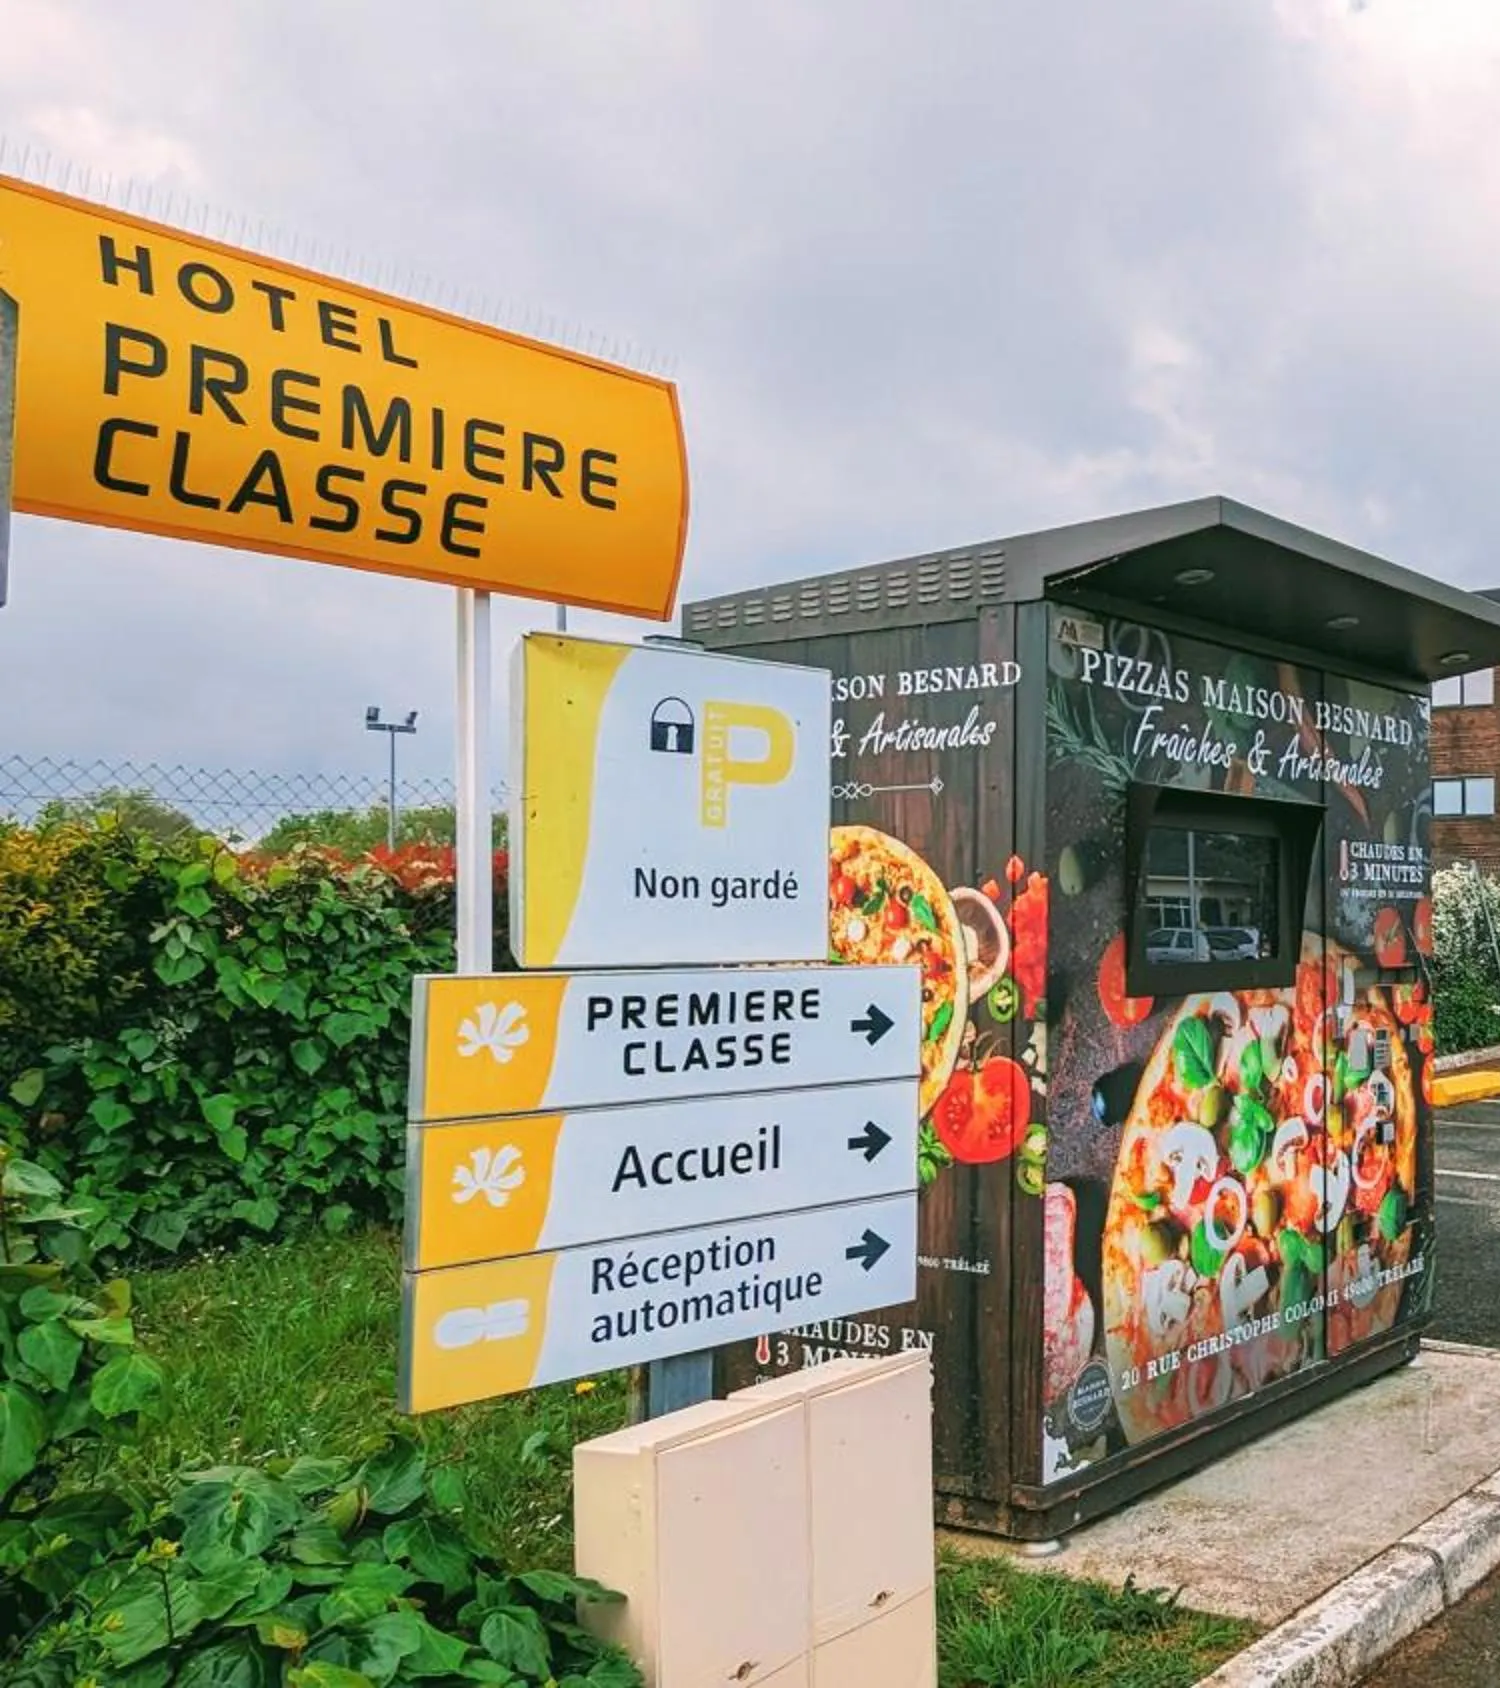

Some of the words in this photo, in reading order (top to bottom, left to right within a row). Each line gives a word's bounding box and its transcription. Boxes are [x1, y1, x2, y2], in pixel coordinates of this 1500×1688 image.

[98, 234, 419, 369] HOTEL
[103, 321, 619, 512] PREMIERE
[92, 417, 488, 558] CLASSE
[831, 675, 887, 702] SON
[897, 661, 1022, 696] BESNARD
[1080, 646, 1191, 703] PIZZAS
[1201, 675, 1305, 726] MAISON
[1315, 701, 1414, 746] BESNARD
[831, 717, 851, 758] &
[857, 704, 997, 757] Artisanales
[1132, 705, 1237, 769] Fraîches
[1247, 730, 1273, 776] &
[1277, 733, 1384, 791] Artisanales
[706, 710, 728, 820] GRATUIT
[1349, 862, 1359, 881] 3
[1363, 863, 1425, 883] MINUTES
[1350, 841, 1405, 861] CHAUDES
[1408, 846, 1423, 861] EN
[634, 867, 701, 900] Non
[711, 870, 798, 908] gardé
[586, 987, 821, 1032] PREMIERE
[622, 1032, 792, 1077] CLASSE
[611, 1124, 782, 1193] Accueil
[591, 1233, 776, 1295] Réception
[589, 1269, 824, 1344] automatique
[782, 1319, 891, 1350] AUDES
[900, 1327, 936, 1352] EN
[776, 1340, 790, 1367] 3
[1121, 1366, 1141, 1392] 20
[1146, 1350, 1182, 1381] RUE
[1186, 1311, 1281, 1363] CHRISTOPHE
